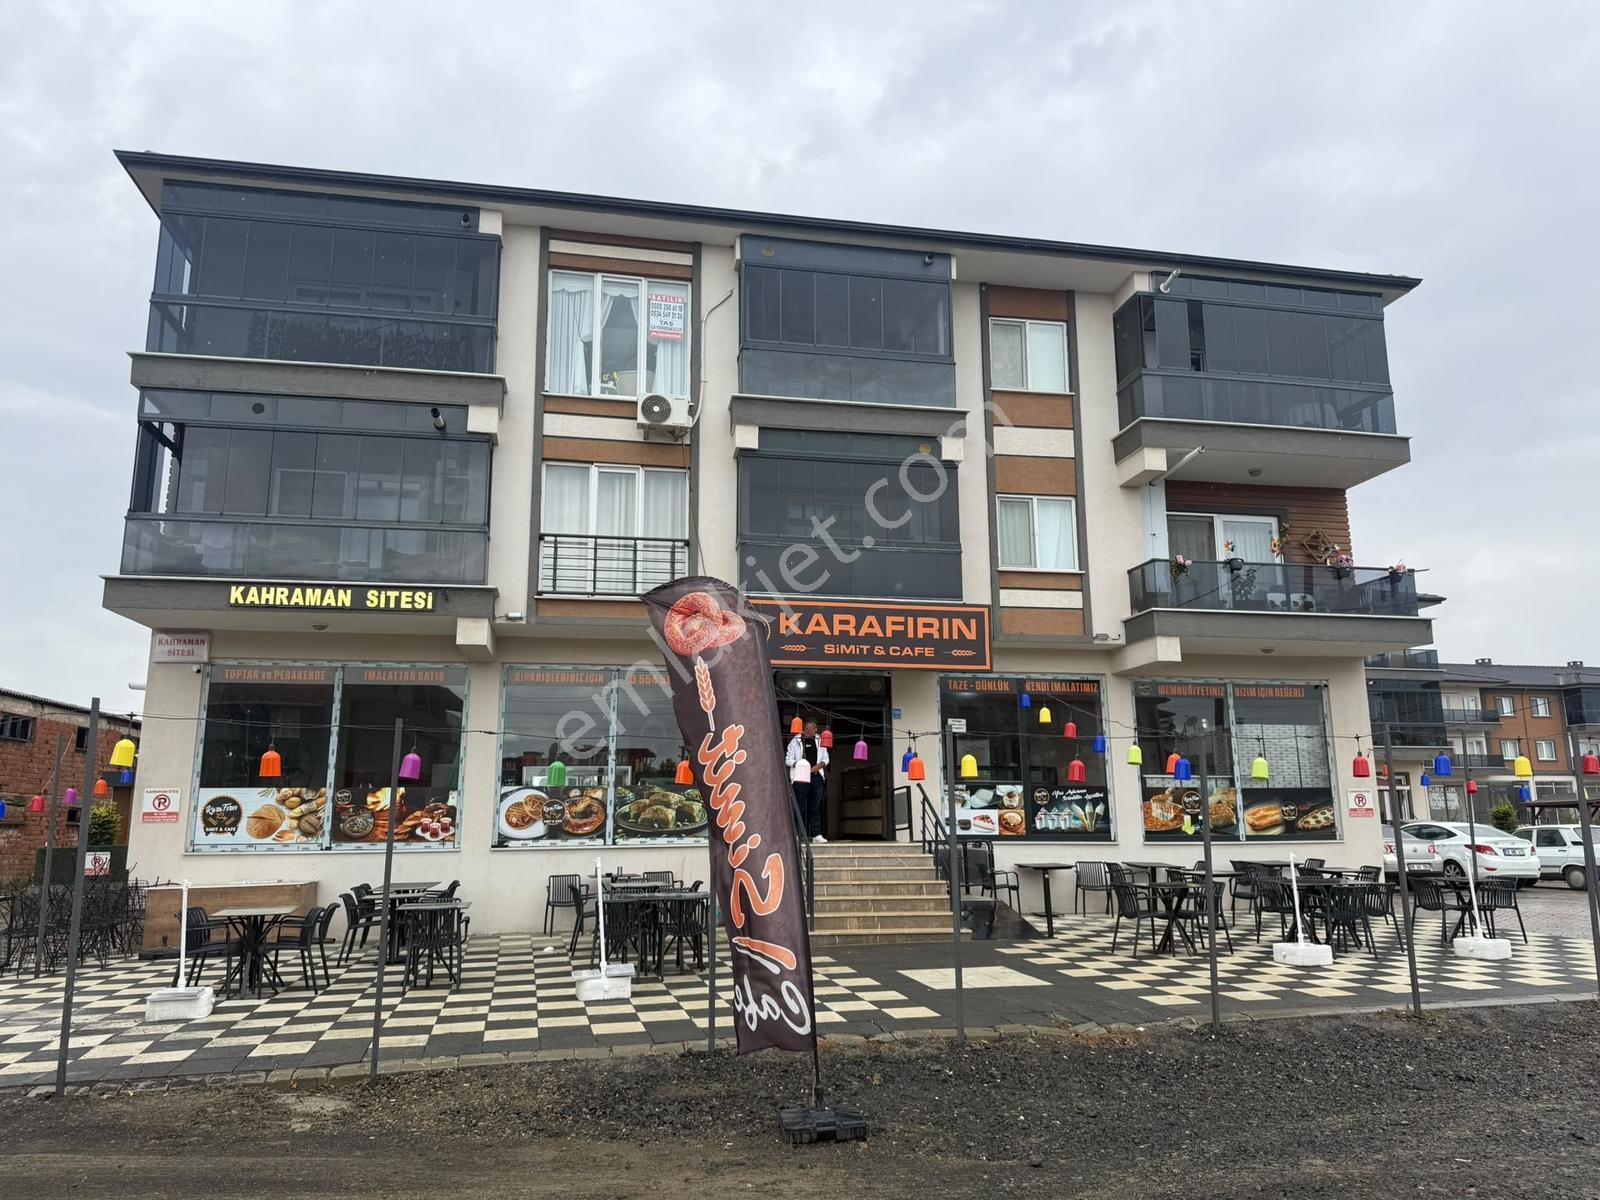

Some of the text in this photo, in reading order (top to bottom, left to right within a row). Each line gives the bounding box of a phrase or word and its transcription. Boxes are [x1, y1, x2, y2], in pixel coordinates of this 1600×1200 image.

[229, 585, 352, 607] KAHRAMAN
[779, 612, 977, 640] KARAFIRIN
[158, 638, 206, 646] KAHRAMAN
[873, 645, 886, 656] &
[889, 646, 935, 657] CAFE
[948, 680, 969, 690] TAZE
